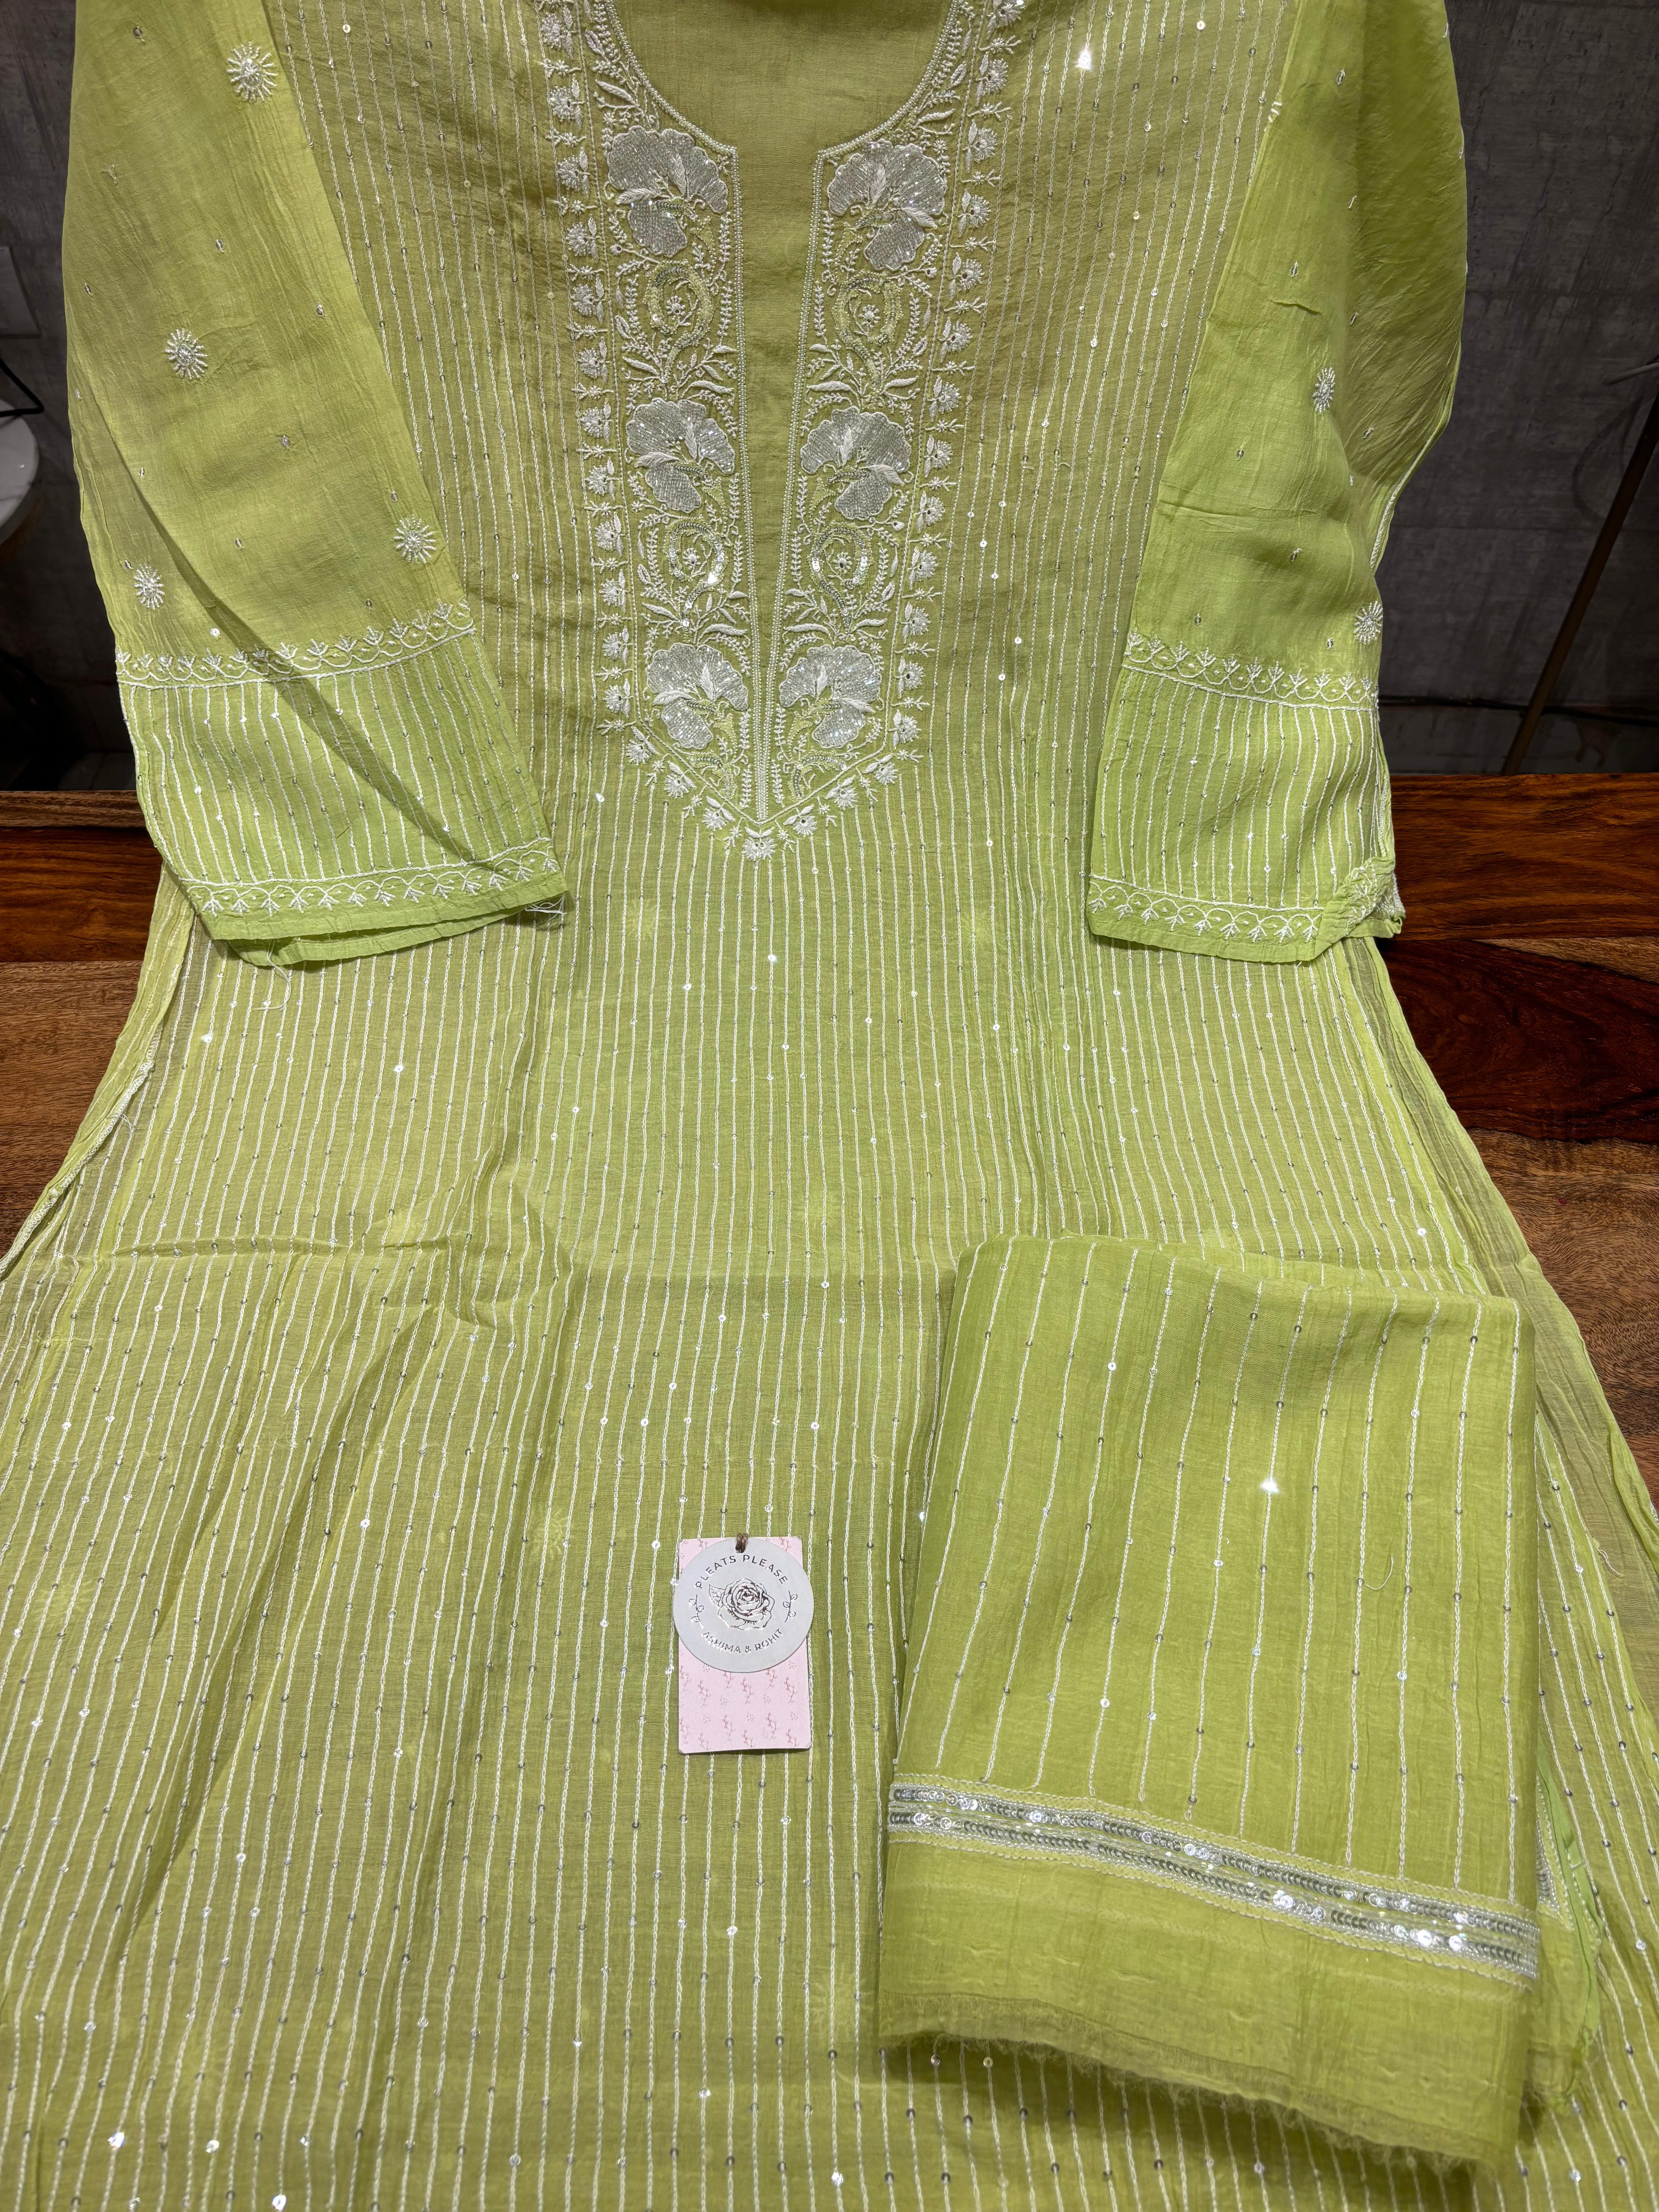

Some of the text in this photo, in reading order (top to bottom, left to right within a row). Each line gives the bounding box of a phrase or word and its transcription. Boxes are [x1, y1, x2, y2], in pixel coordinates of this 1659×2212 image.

[695, 1554, 788, 1589] PLEATS PLEASE
[703, 1632, 741, 1653] ASHIMA
[755, 1628, 783, 1650] ROHIT
